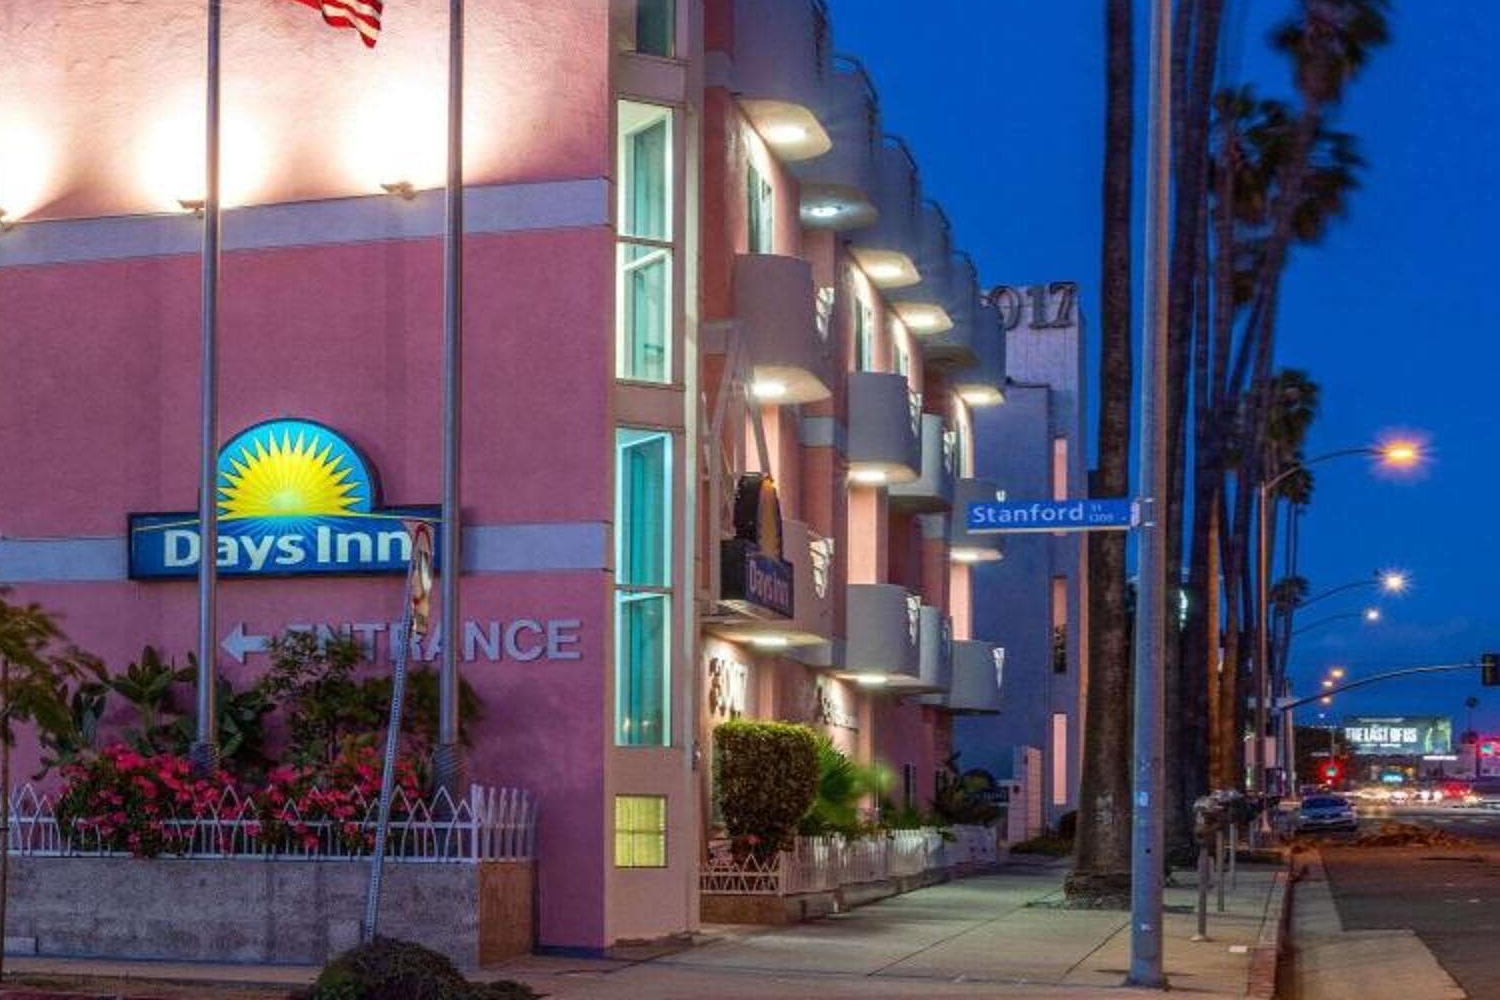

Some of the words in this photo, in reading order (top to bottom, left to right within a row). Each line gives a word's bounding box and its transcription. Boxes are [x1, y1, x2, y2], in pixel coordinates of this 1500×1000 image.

[972, 503, 1084, 523] Stanford
[163, 529, 306, 570] Days
[316, 526, 412, 564] Inn
[285, 619, 582, 662] NTRANCE
[1364, 726, 1389, 743] LAST
